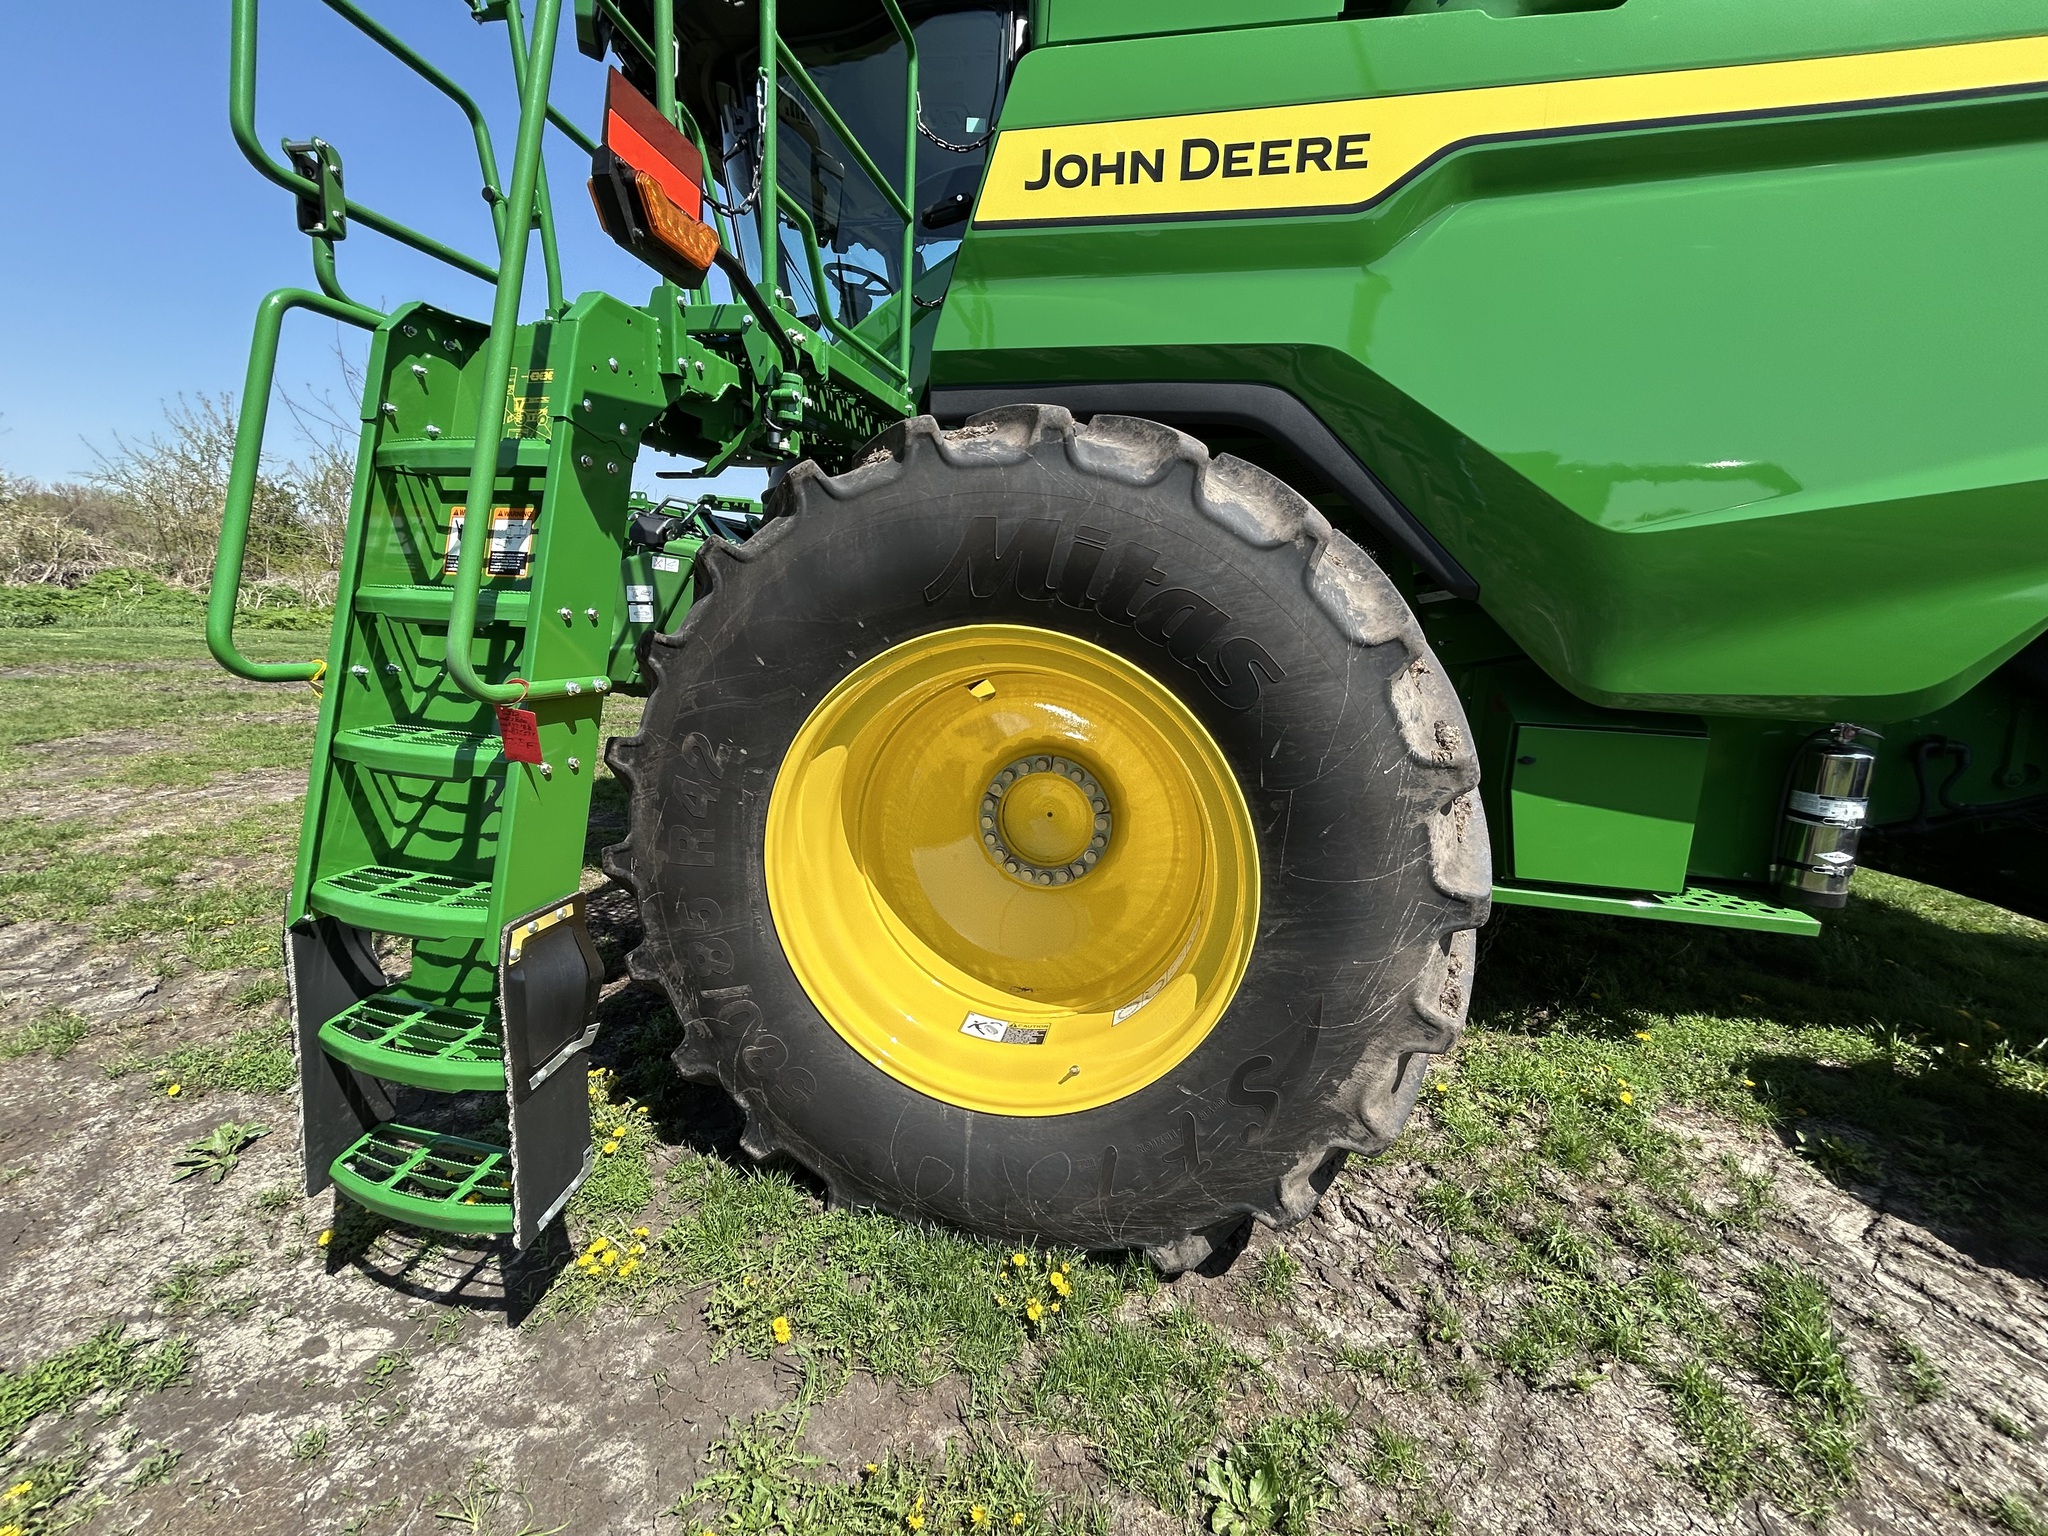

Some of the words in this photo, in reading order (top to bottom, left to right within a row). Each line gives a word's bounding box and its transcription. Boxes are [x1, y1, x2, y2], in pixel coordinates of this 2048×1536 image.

[1025, 148, 1164, 191] JOHN
[1180, 133, 1371, 181] DEERE
[923, 515, 1287, 710] Mitas
